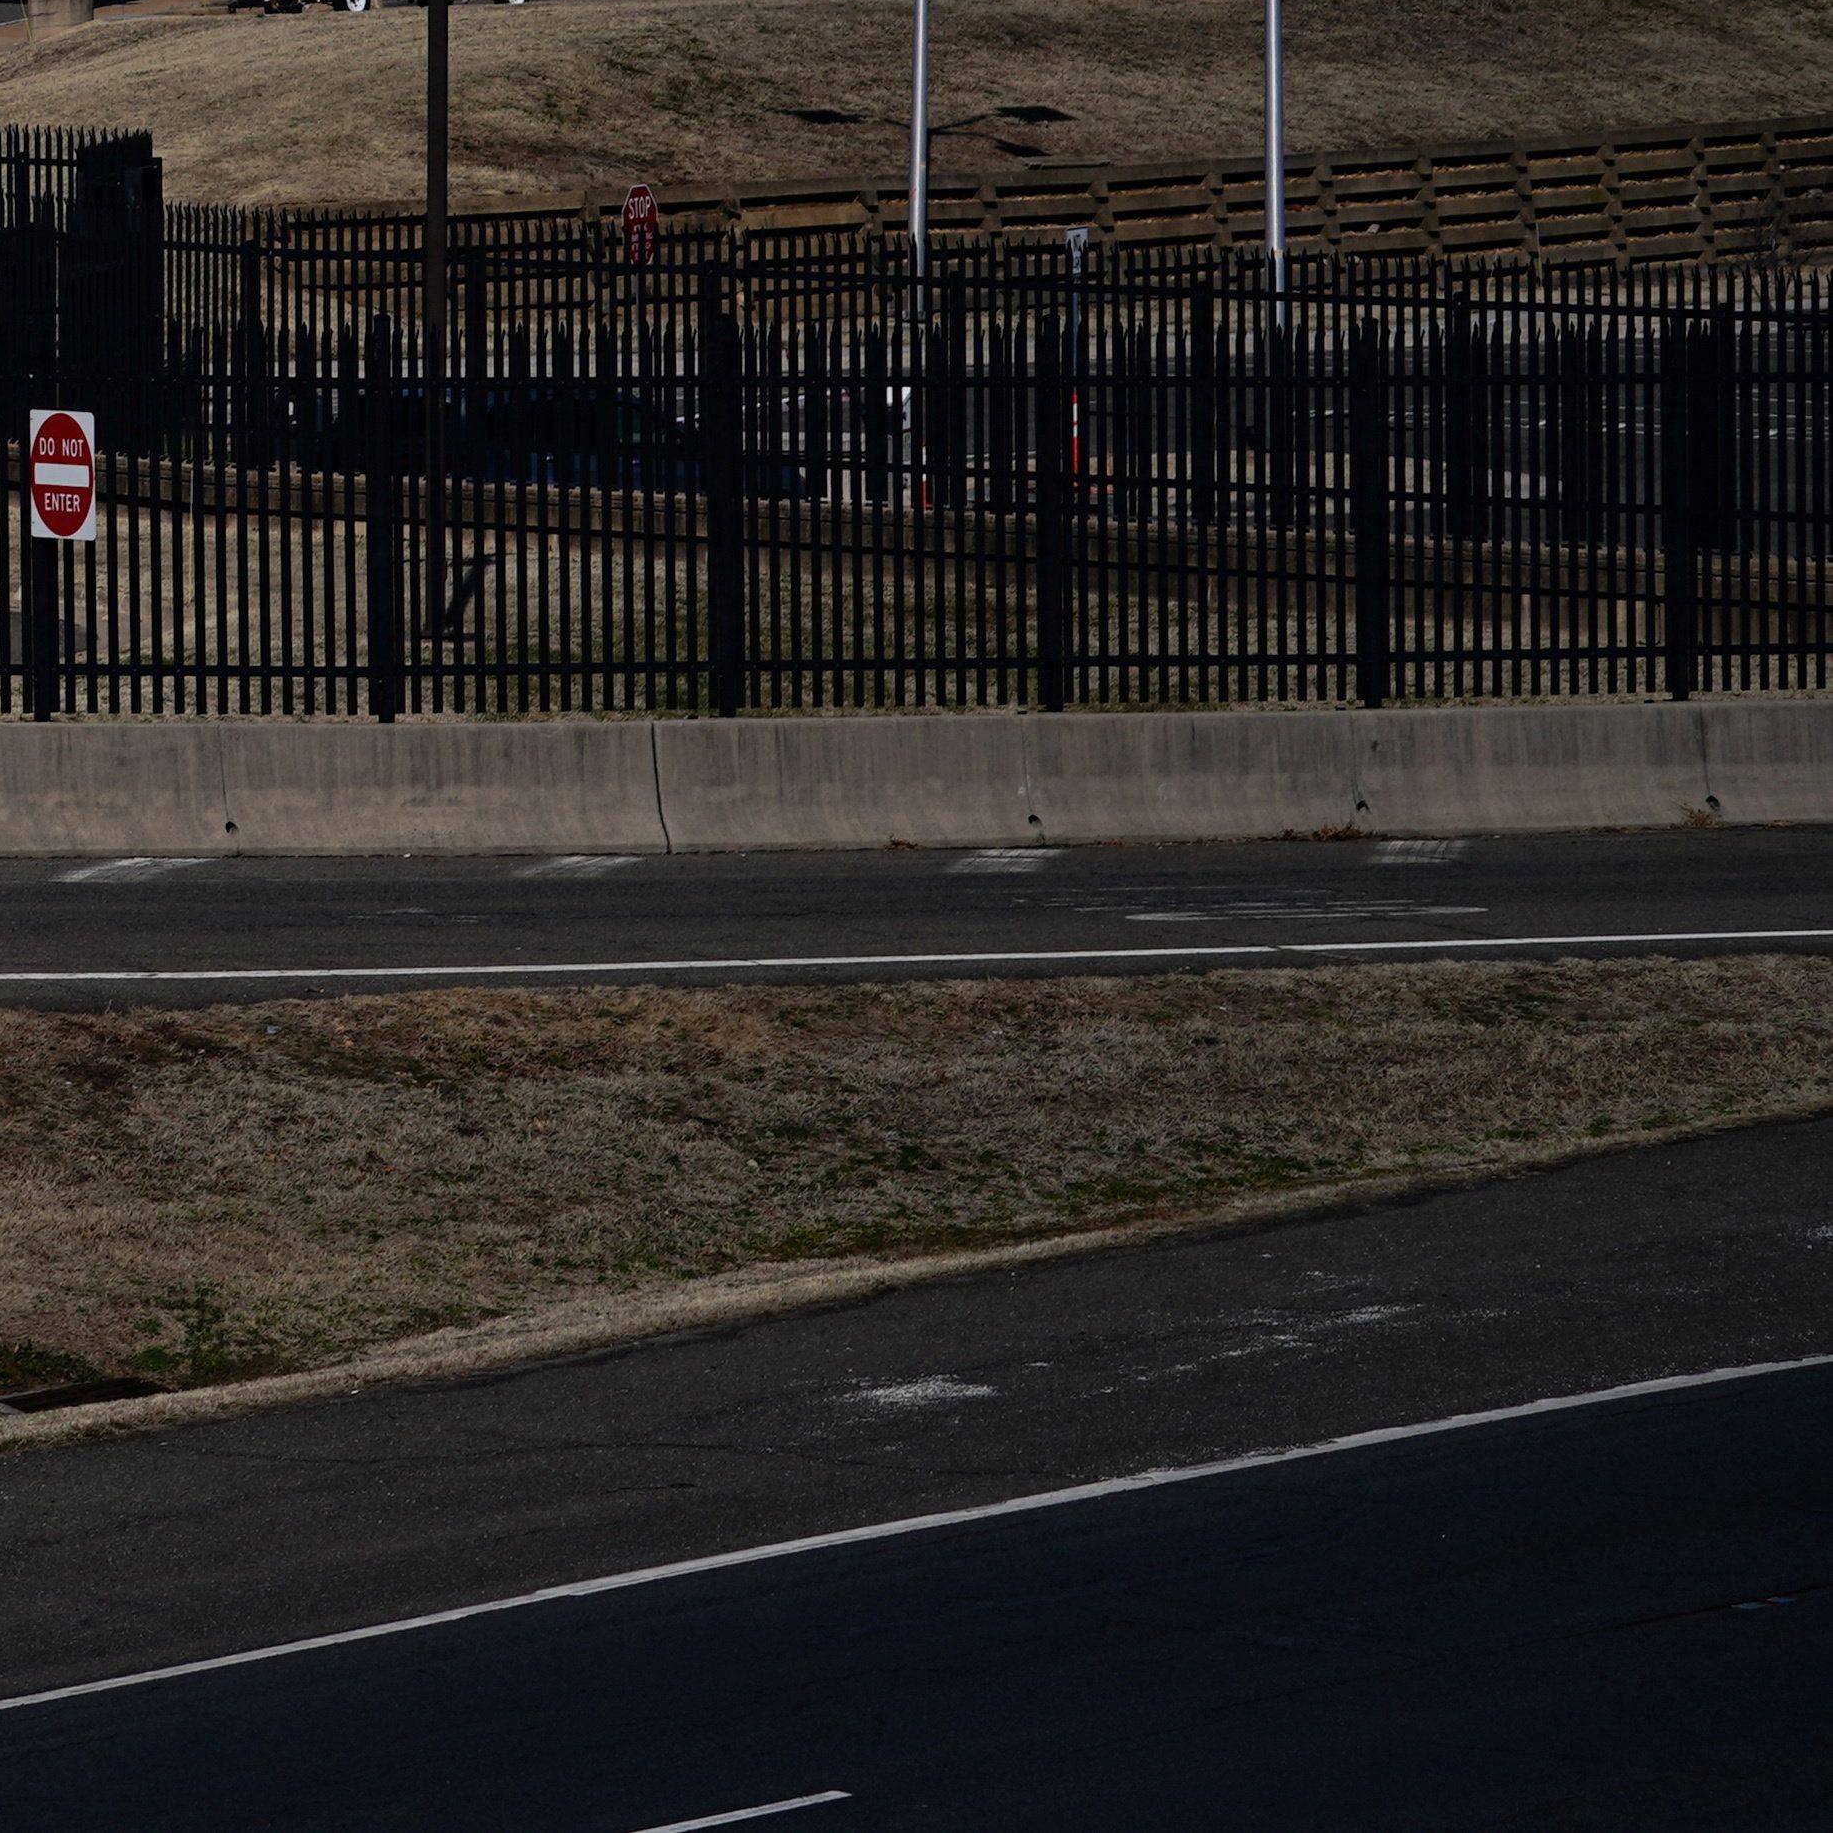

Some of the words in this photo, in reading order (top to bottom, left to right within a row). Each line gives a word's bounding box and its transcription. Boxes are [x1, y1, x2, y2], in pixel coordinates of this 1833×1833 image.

[628, 195, 651, 220] STOP
[39, 437, 55, 456] DO
[62, 438, 84, 457] NOT
[44, 492, 81, 512] ENTER
